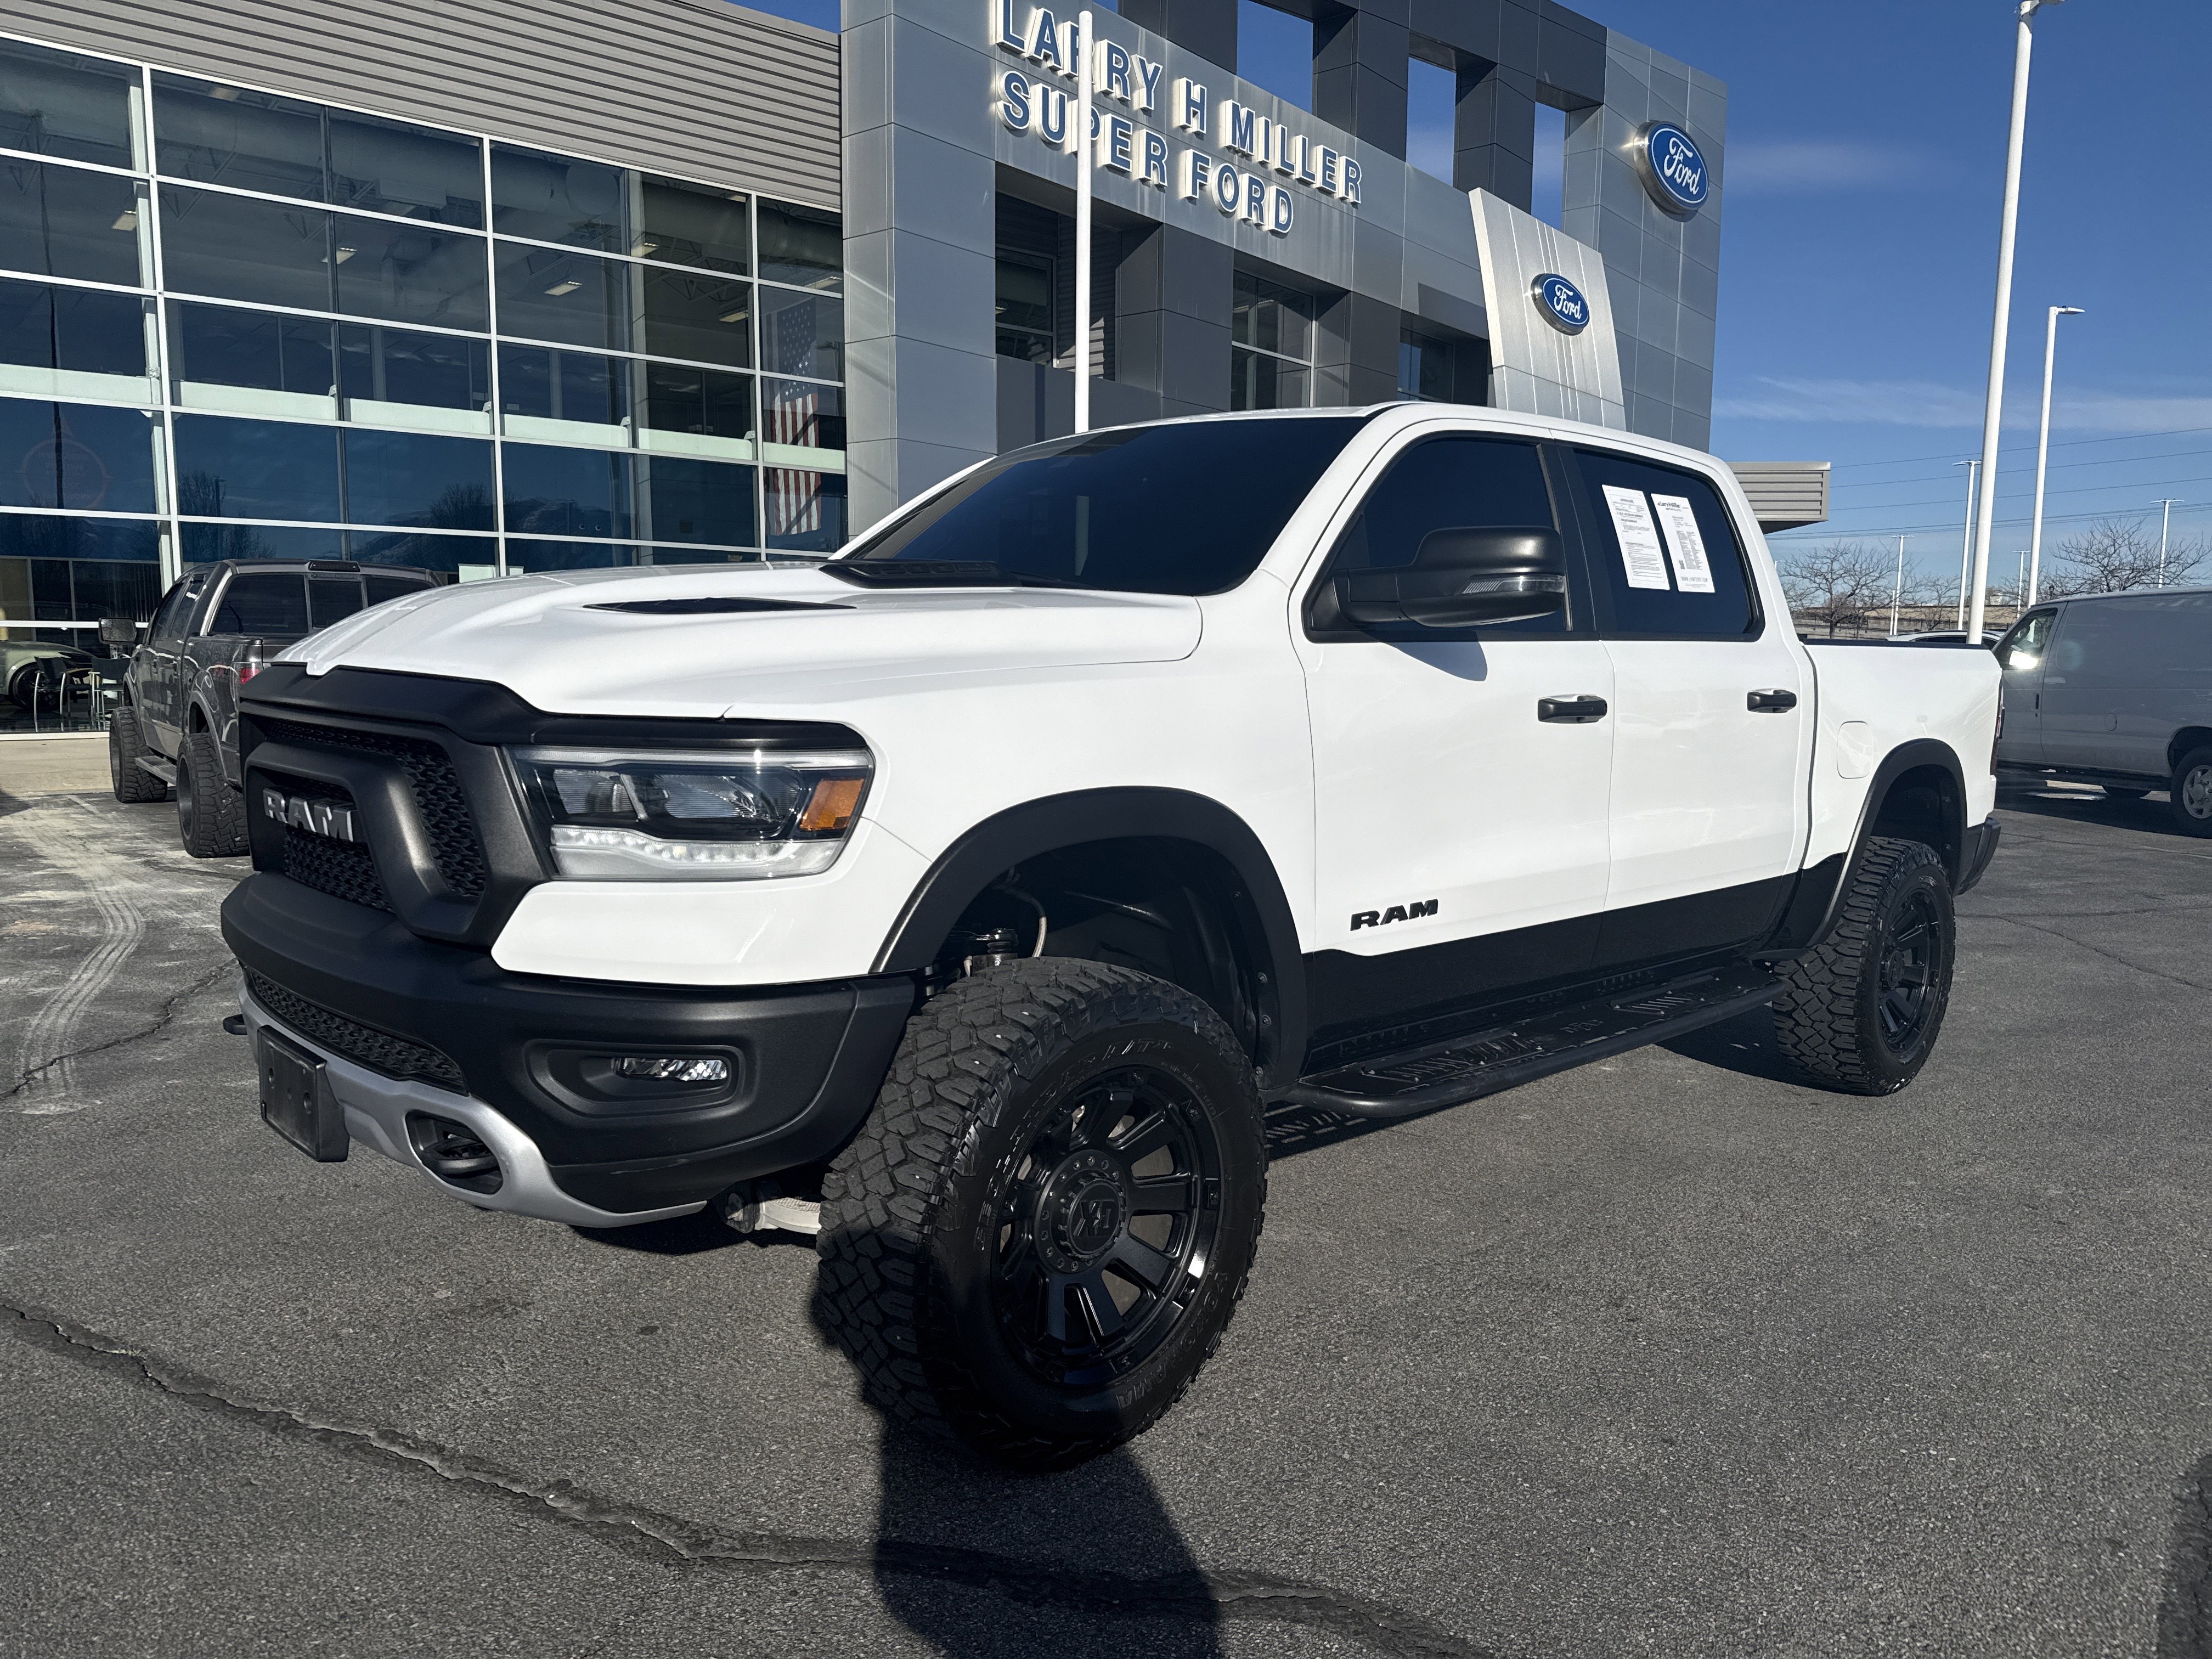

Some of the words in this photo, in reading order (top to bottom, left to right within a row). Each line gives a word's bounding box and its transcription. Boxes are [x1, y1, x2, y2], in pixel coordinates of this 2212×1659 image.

[1179, 77, 1206, 134] H
[1225, 99, 1362, 204] MILLER
[1663, 137, 1701, 195] Ford
[1185, 149, 1293, 233] FORD
[1554, 284, 1582, 320] Ford
[262, 788, 354, 843] RAM
[1350, 899, 1438, 931] RAM
